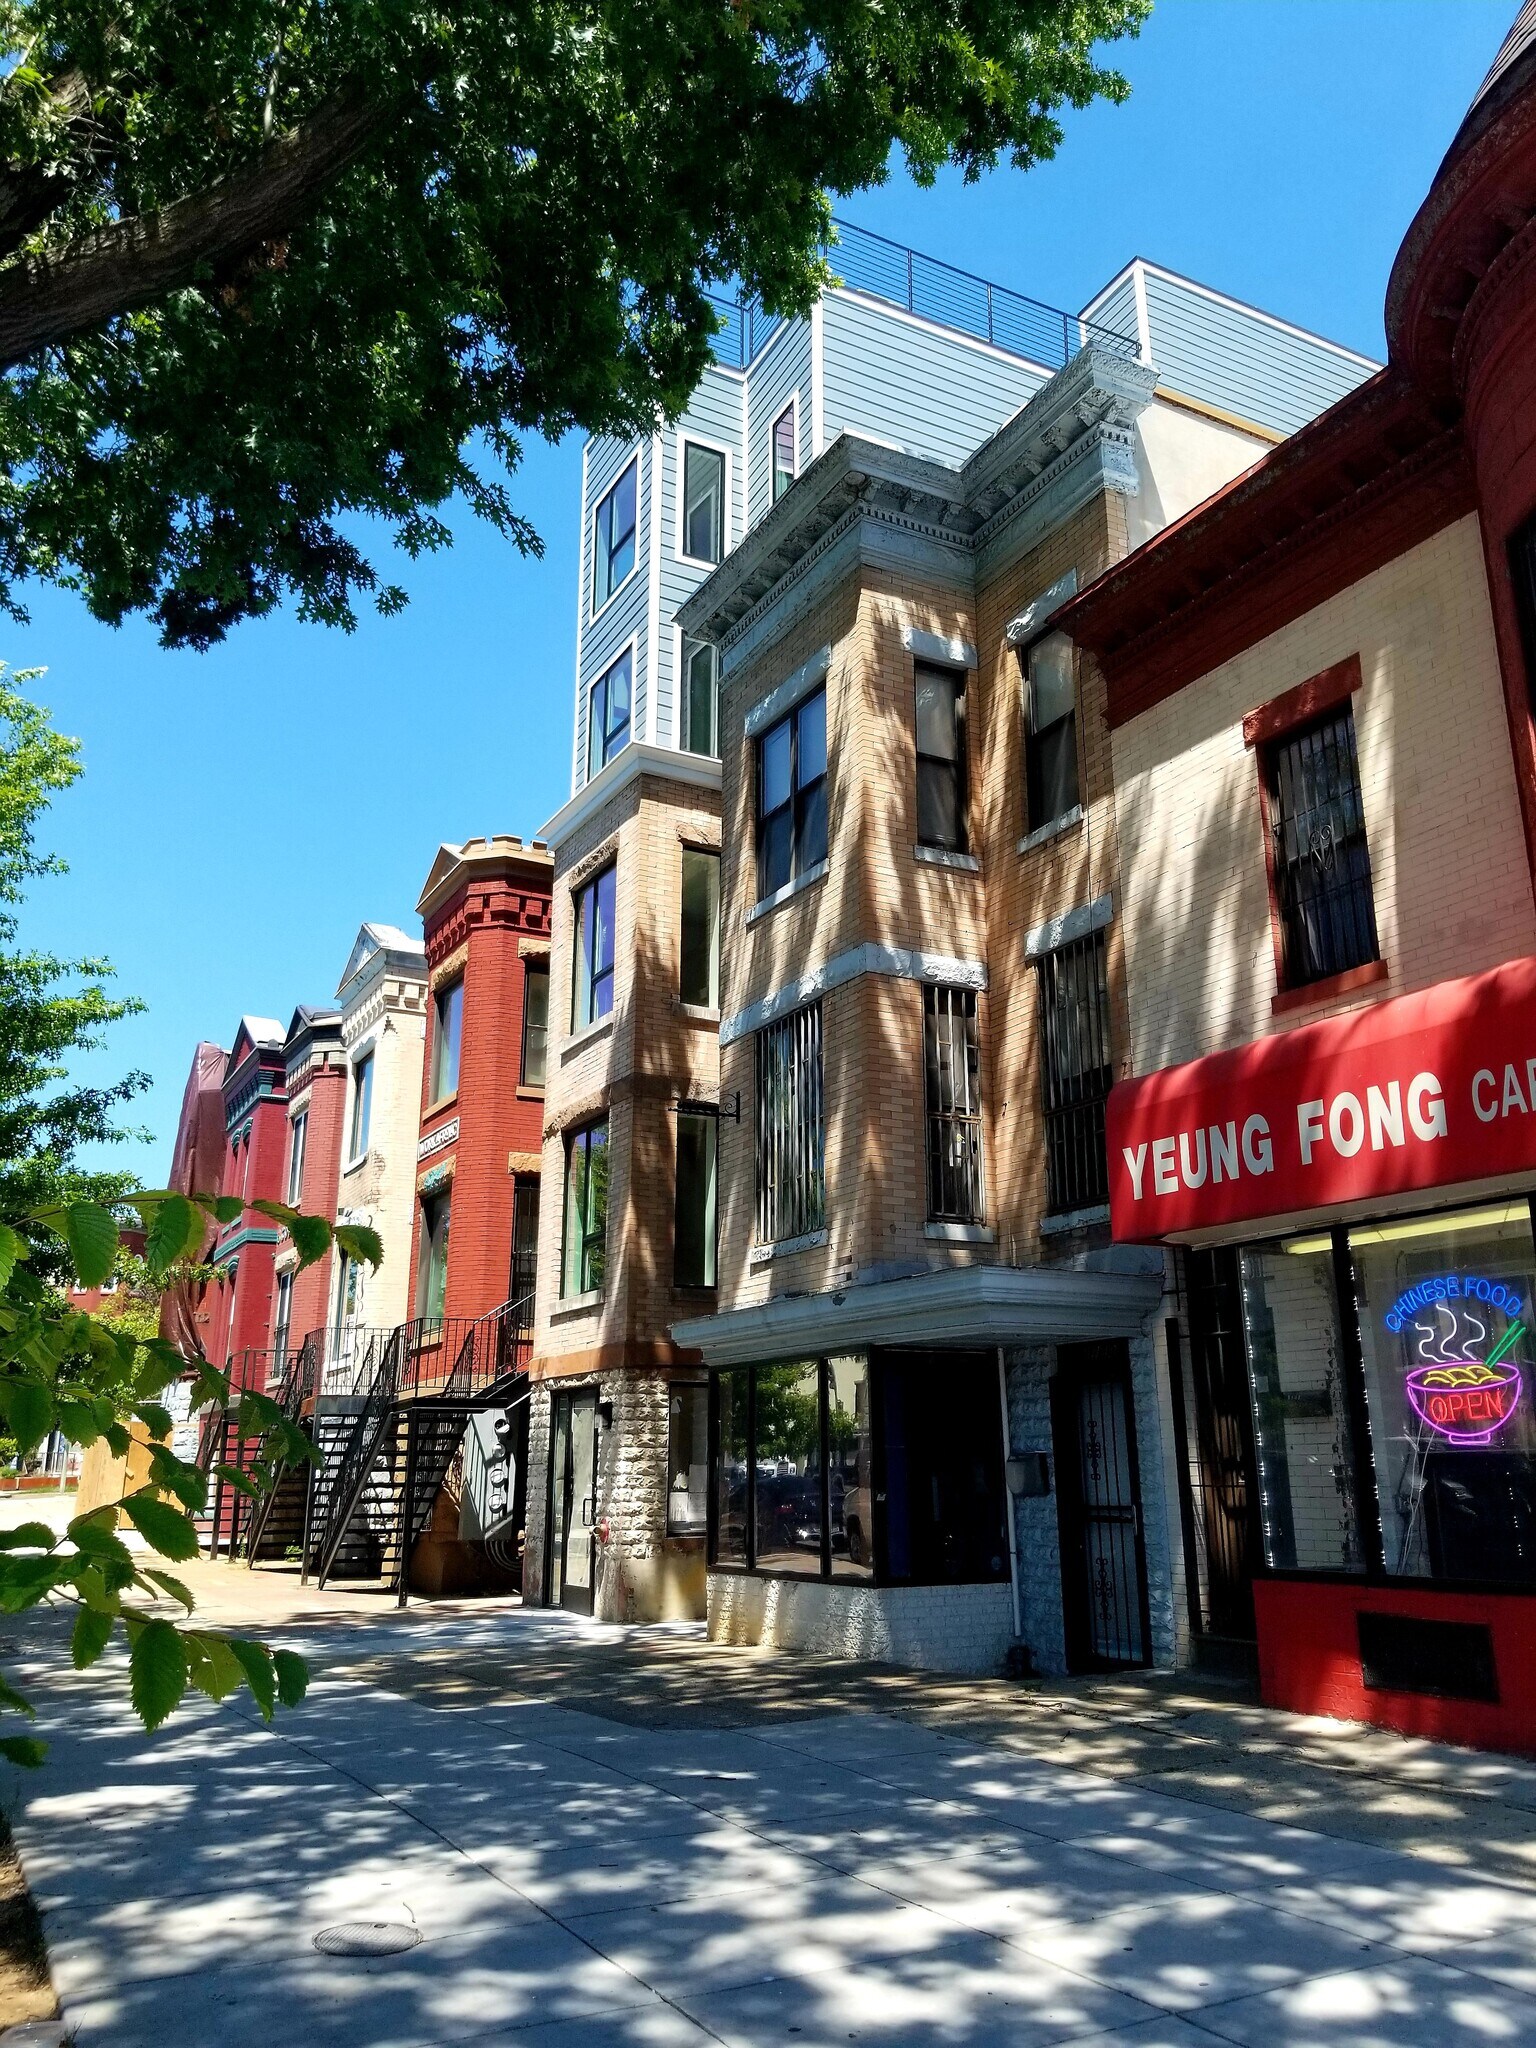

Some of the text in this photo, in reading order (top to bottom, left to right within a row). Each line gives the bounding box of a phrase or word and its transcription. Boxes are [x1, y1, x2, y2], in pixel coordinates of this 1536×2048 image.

[1123, 1113, 1275, 1201] YEUNG
[1297, 1072, 1448, 1165] FONG
[1385, 1277, 1522, 1332] CHINESE FOOD
[1431, 1391, 1505, 1422] OPEN
